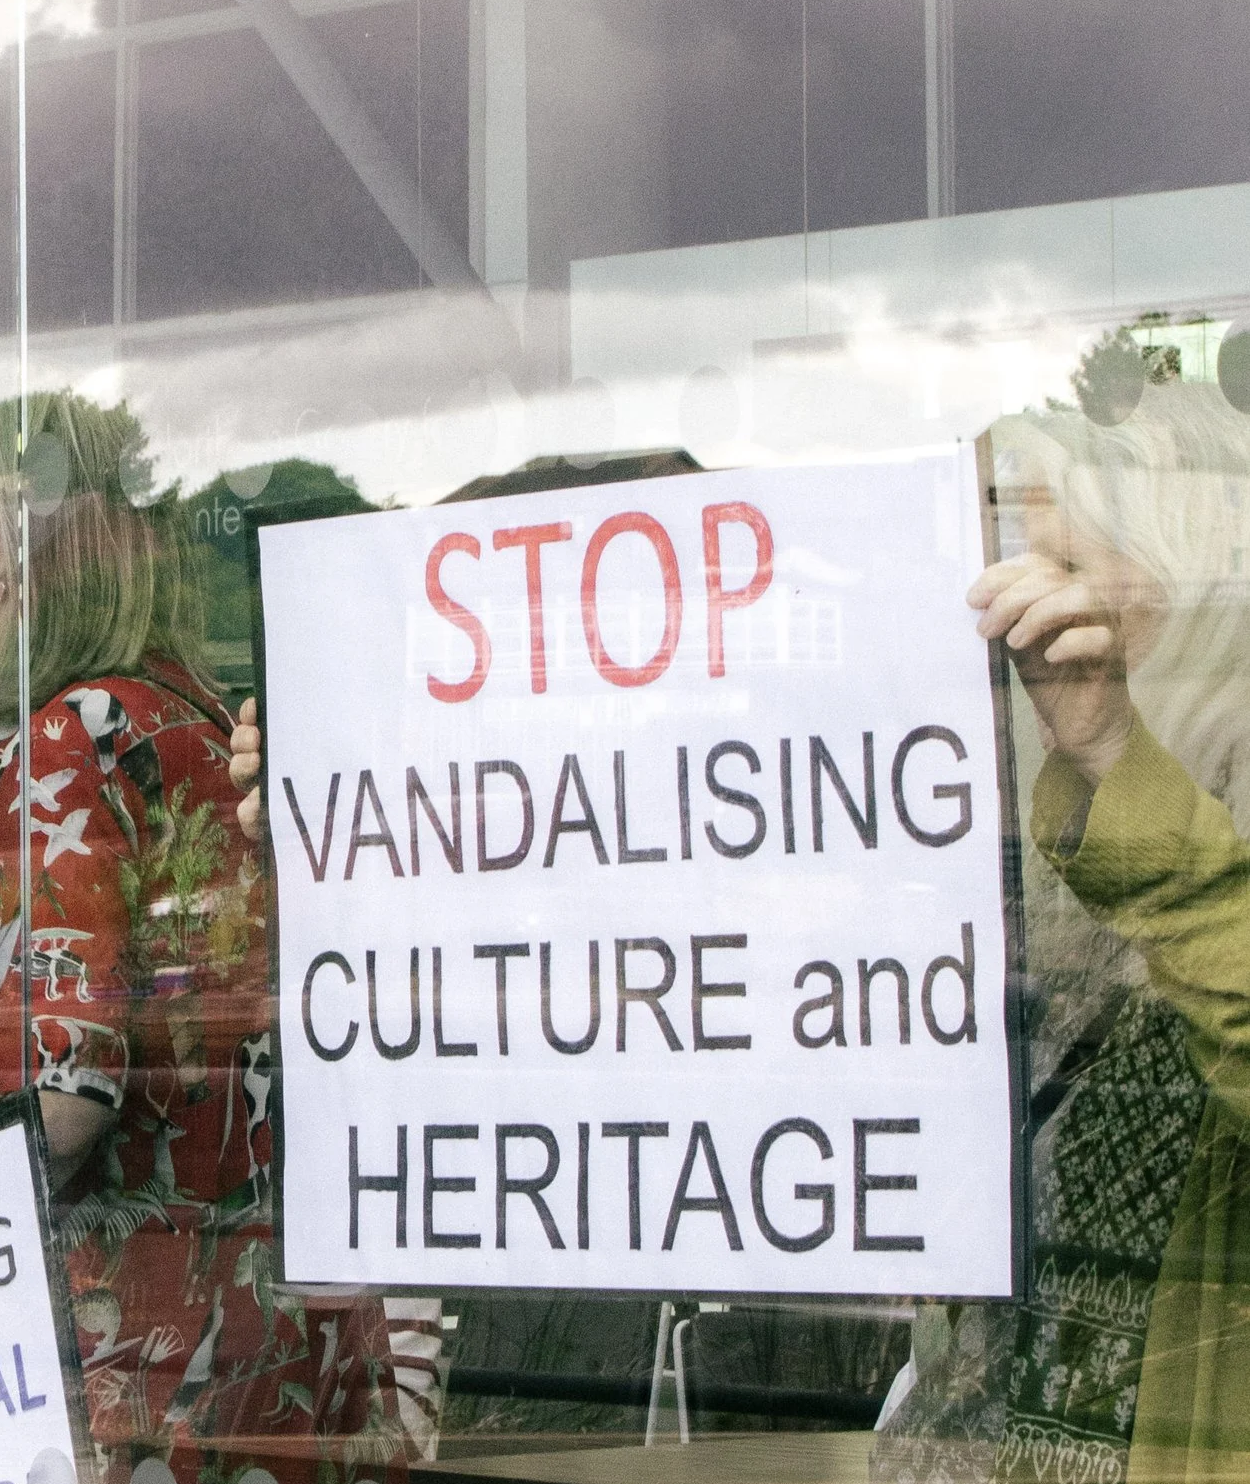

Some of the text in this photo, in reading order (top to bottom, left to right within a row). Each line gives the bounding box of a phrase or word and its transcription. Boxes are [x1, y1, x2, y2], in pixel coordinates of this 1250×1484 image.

[425, 501, 775, 703] STOP
[282, 724, 973, 882] VANDALISING
[301, 922, 978, 1062] CULTURE and
[348, 1117, 926, 1253] HERITAGE
